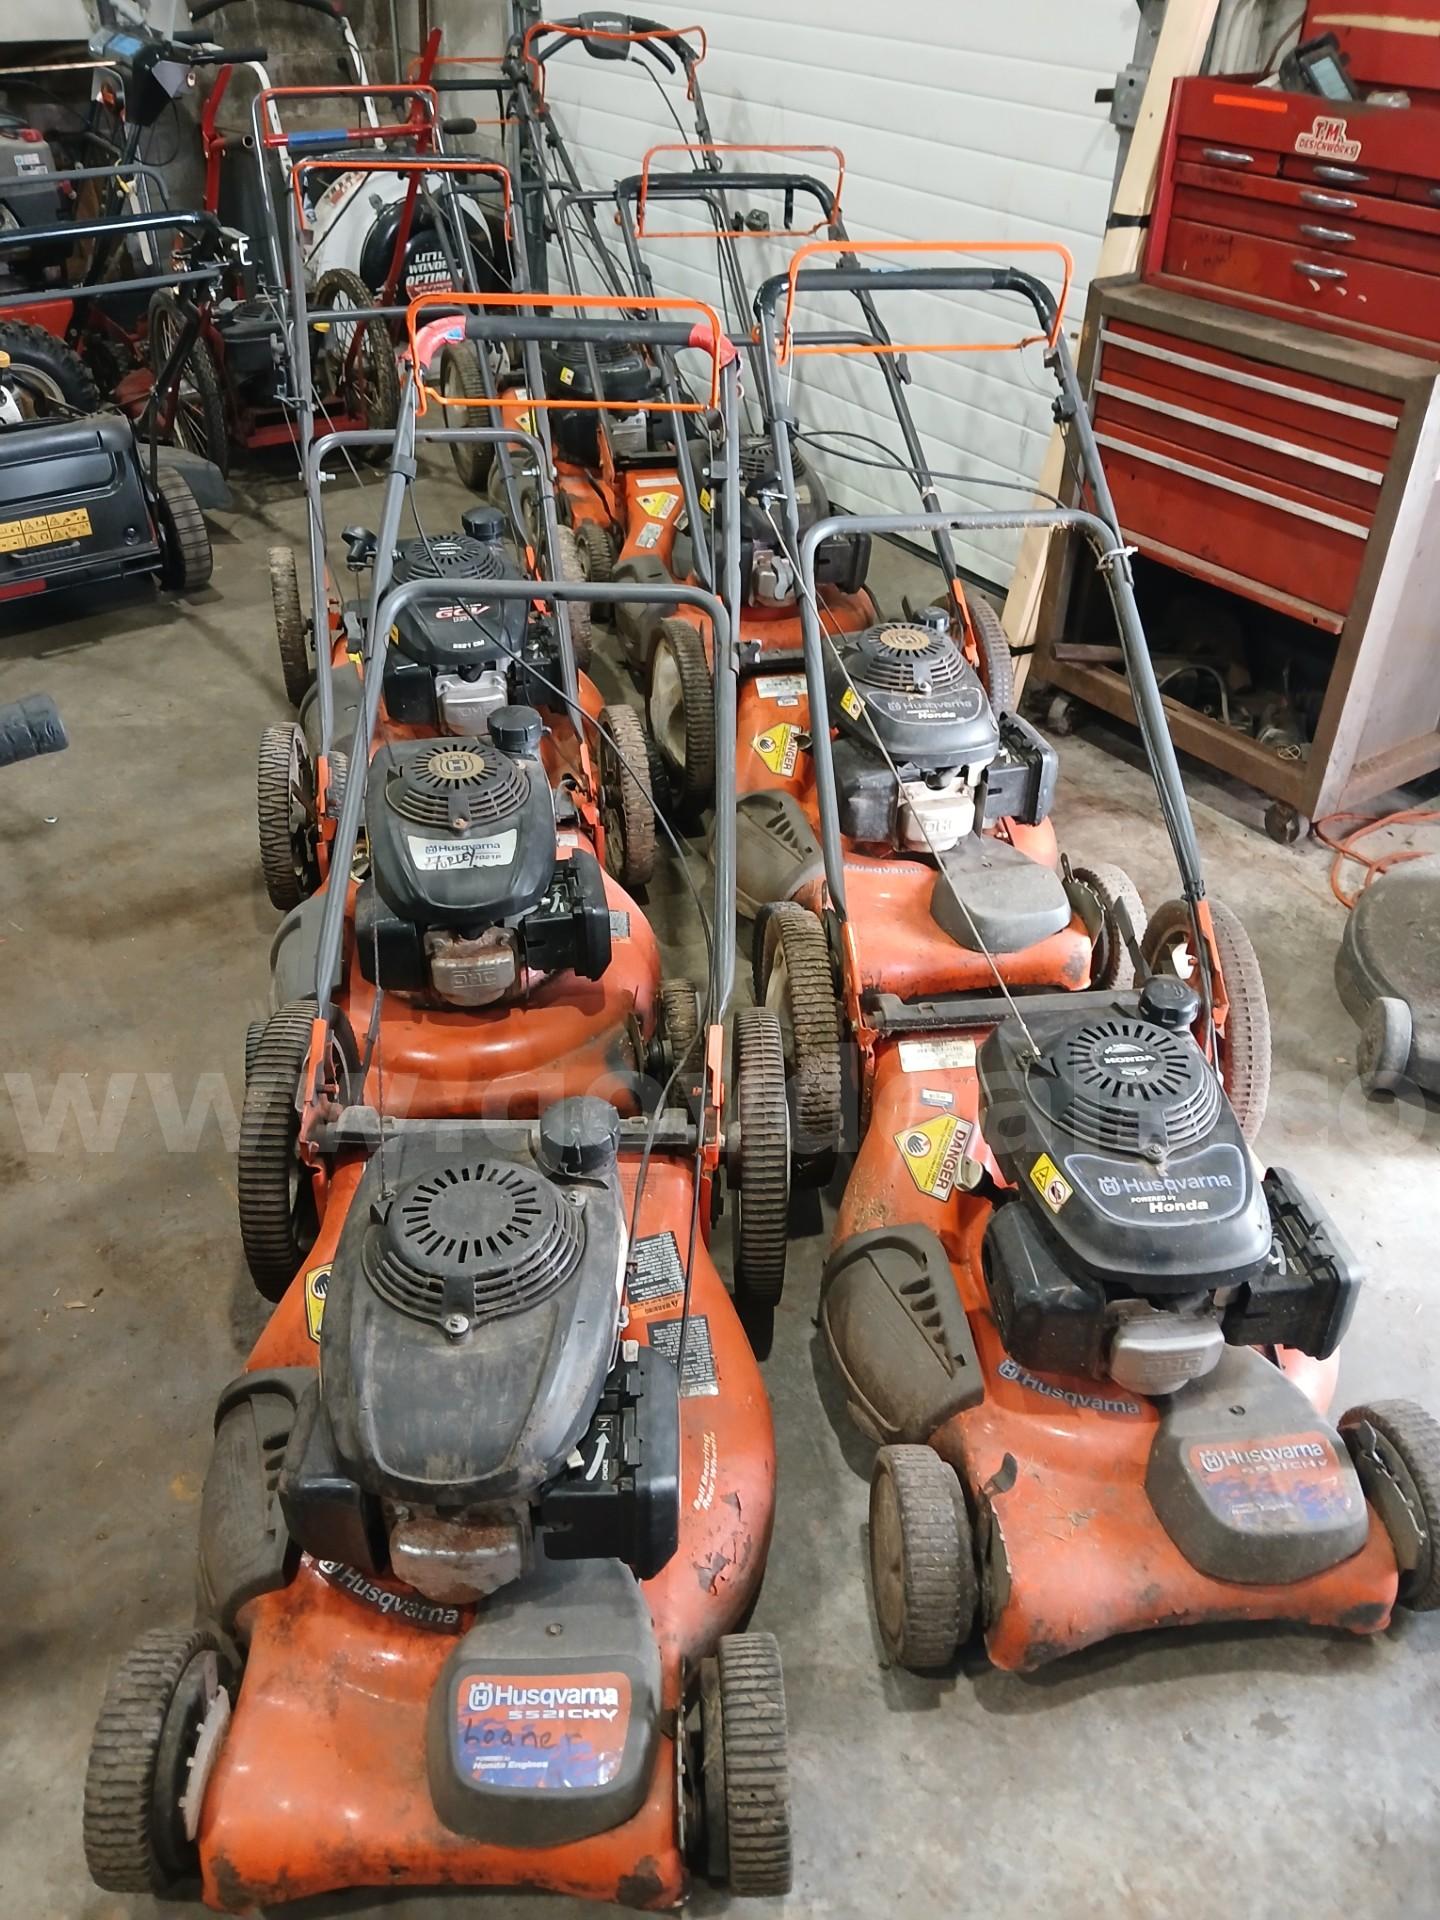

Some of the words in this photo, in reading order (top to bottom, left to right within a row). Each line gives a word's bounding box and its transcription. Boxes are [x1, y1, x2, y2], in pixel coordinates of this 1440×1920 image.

[408, 260, 449, 274] WONDE
[903, 700, 973, 710] Husqvarna
[918, 710, 957, 720] Honda
[438, 842, 501, 852] Husqvarna
[1104, 1055, 1157, 1064] HONDA
[936, 1130, 966, 1190] DANGER
[1122, 1174, 1233, 1195] Husqvarna
[1149, 1199, 1209, 1213] Honda
[1021, 1373, 1140, 1415] Husqvarna
[1221, 1442, 1325, 1467] Husqvarna
[693, 1483, 706, 1511] Ball
[702, 1480, 715, 1511] Rear
[338, 1565, 460, 1626] Husqvarna
[495, 1685, 619, 1709] Husqvarna
